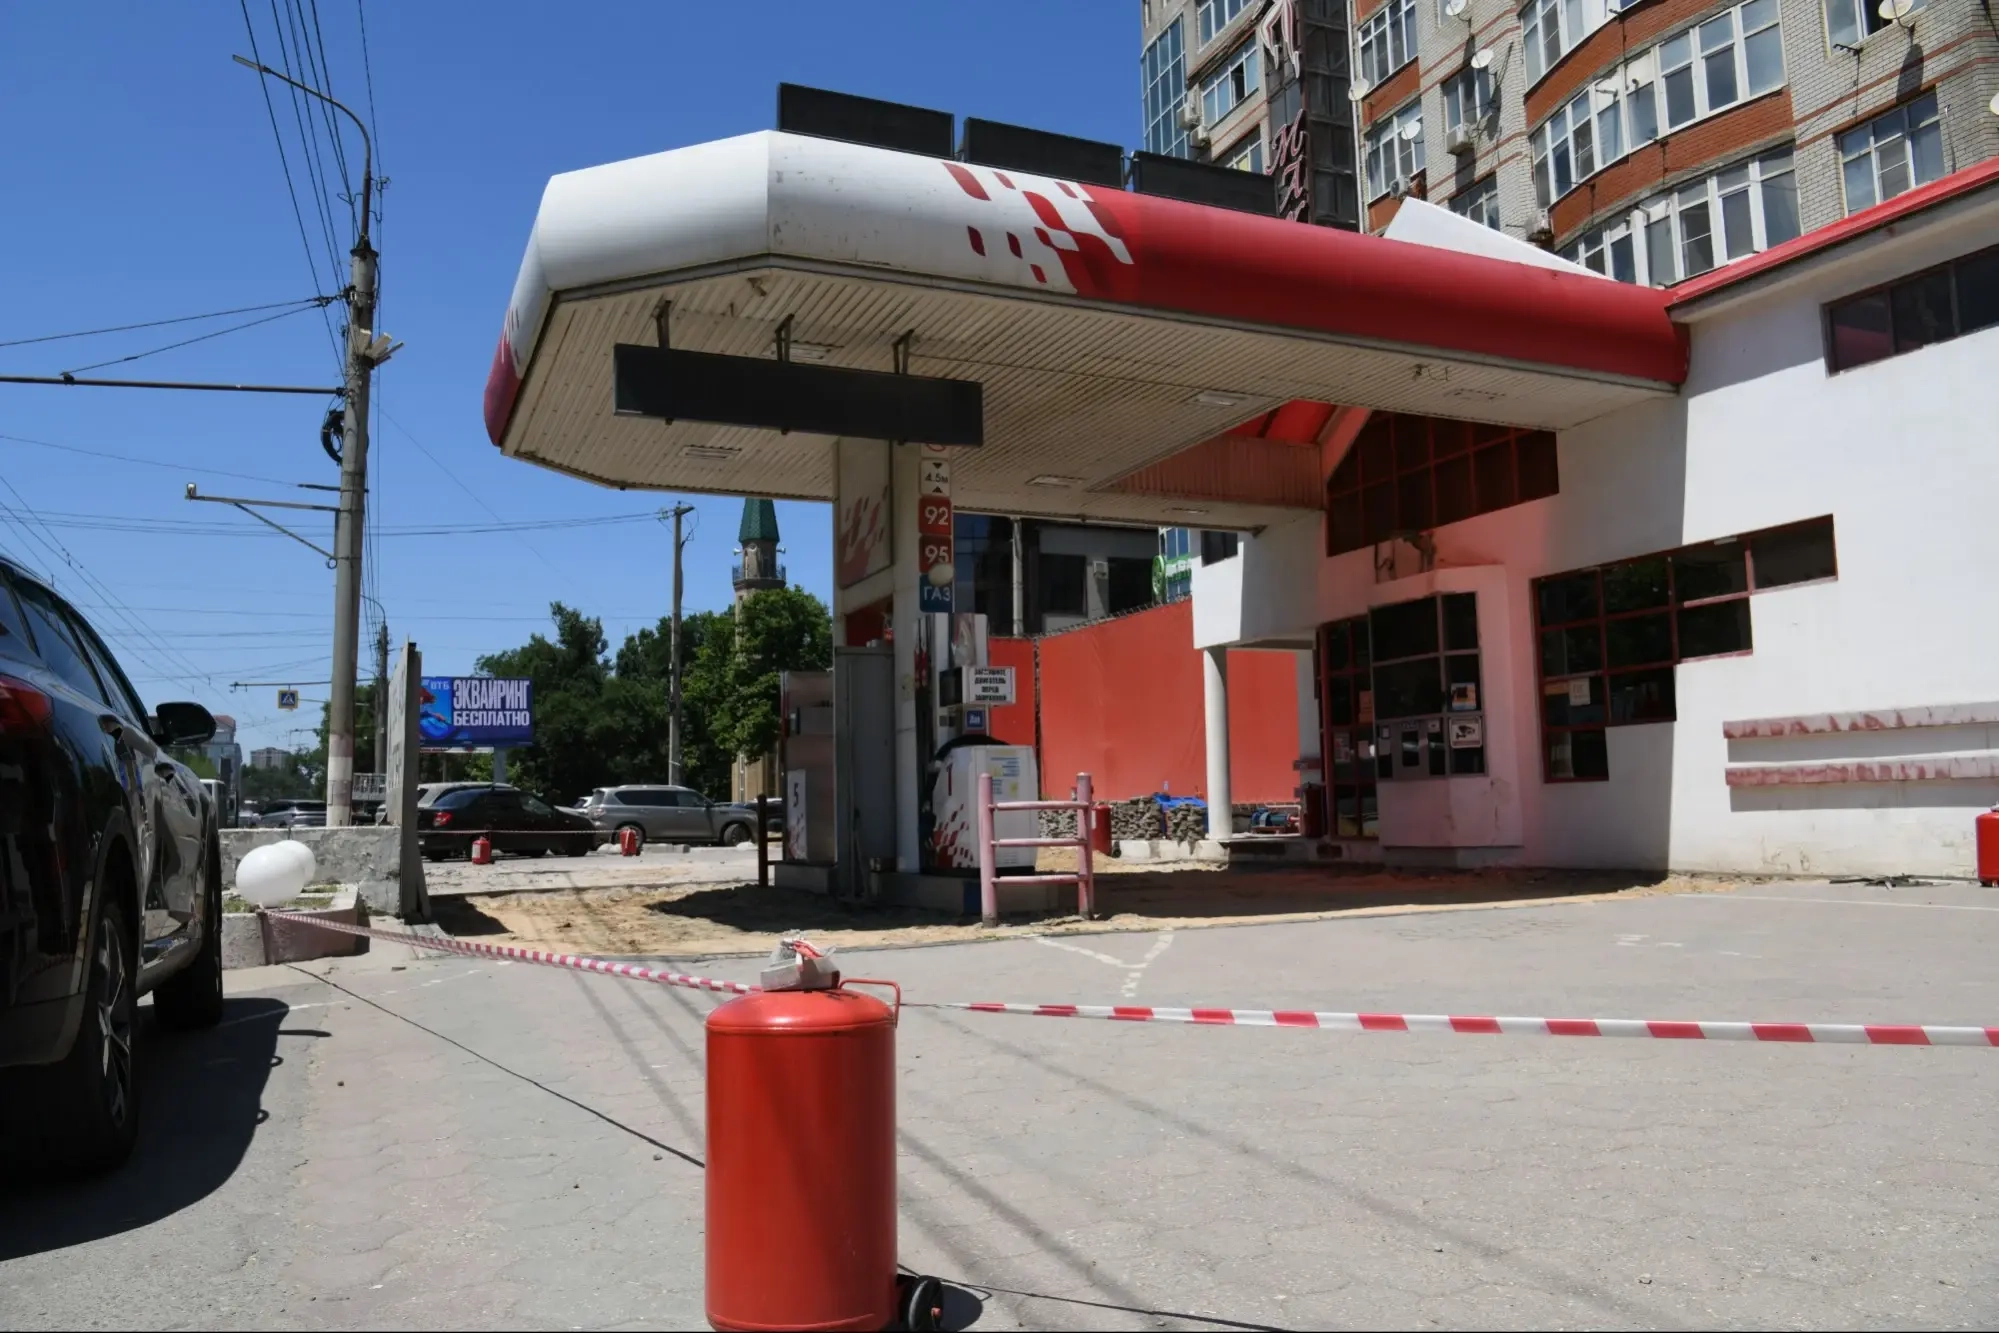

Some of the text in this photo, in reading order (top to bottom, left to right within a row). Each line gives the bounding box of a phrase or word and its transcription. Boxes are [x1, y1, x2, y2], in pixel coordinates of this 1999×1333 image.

[925, 506, 949, 525] 92
[925, 545, 949, 564] 95
[923, 586, 951, 602] ГАЗ
[430, 680, 450, 690] ВТБ
[453, 711, 530, 726] БЕСПЛАТНО
[946, 763, 953, 796] 1
[793, 782, 799, 808] 5
